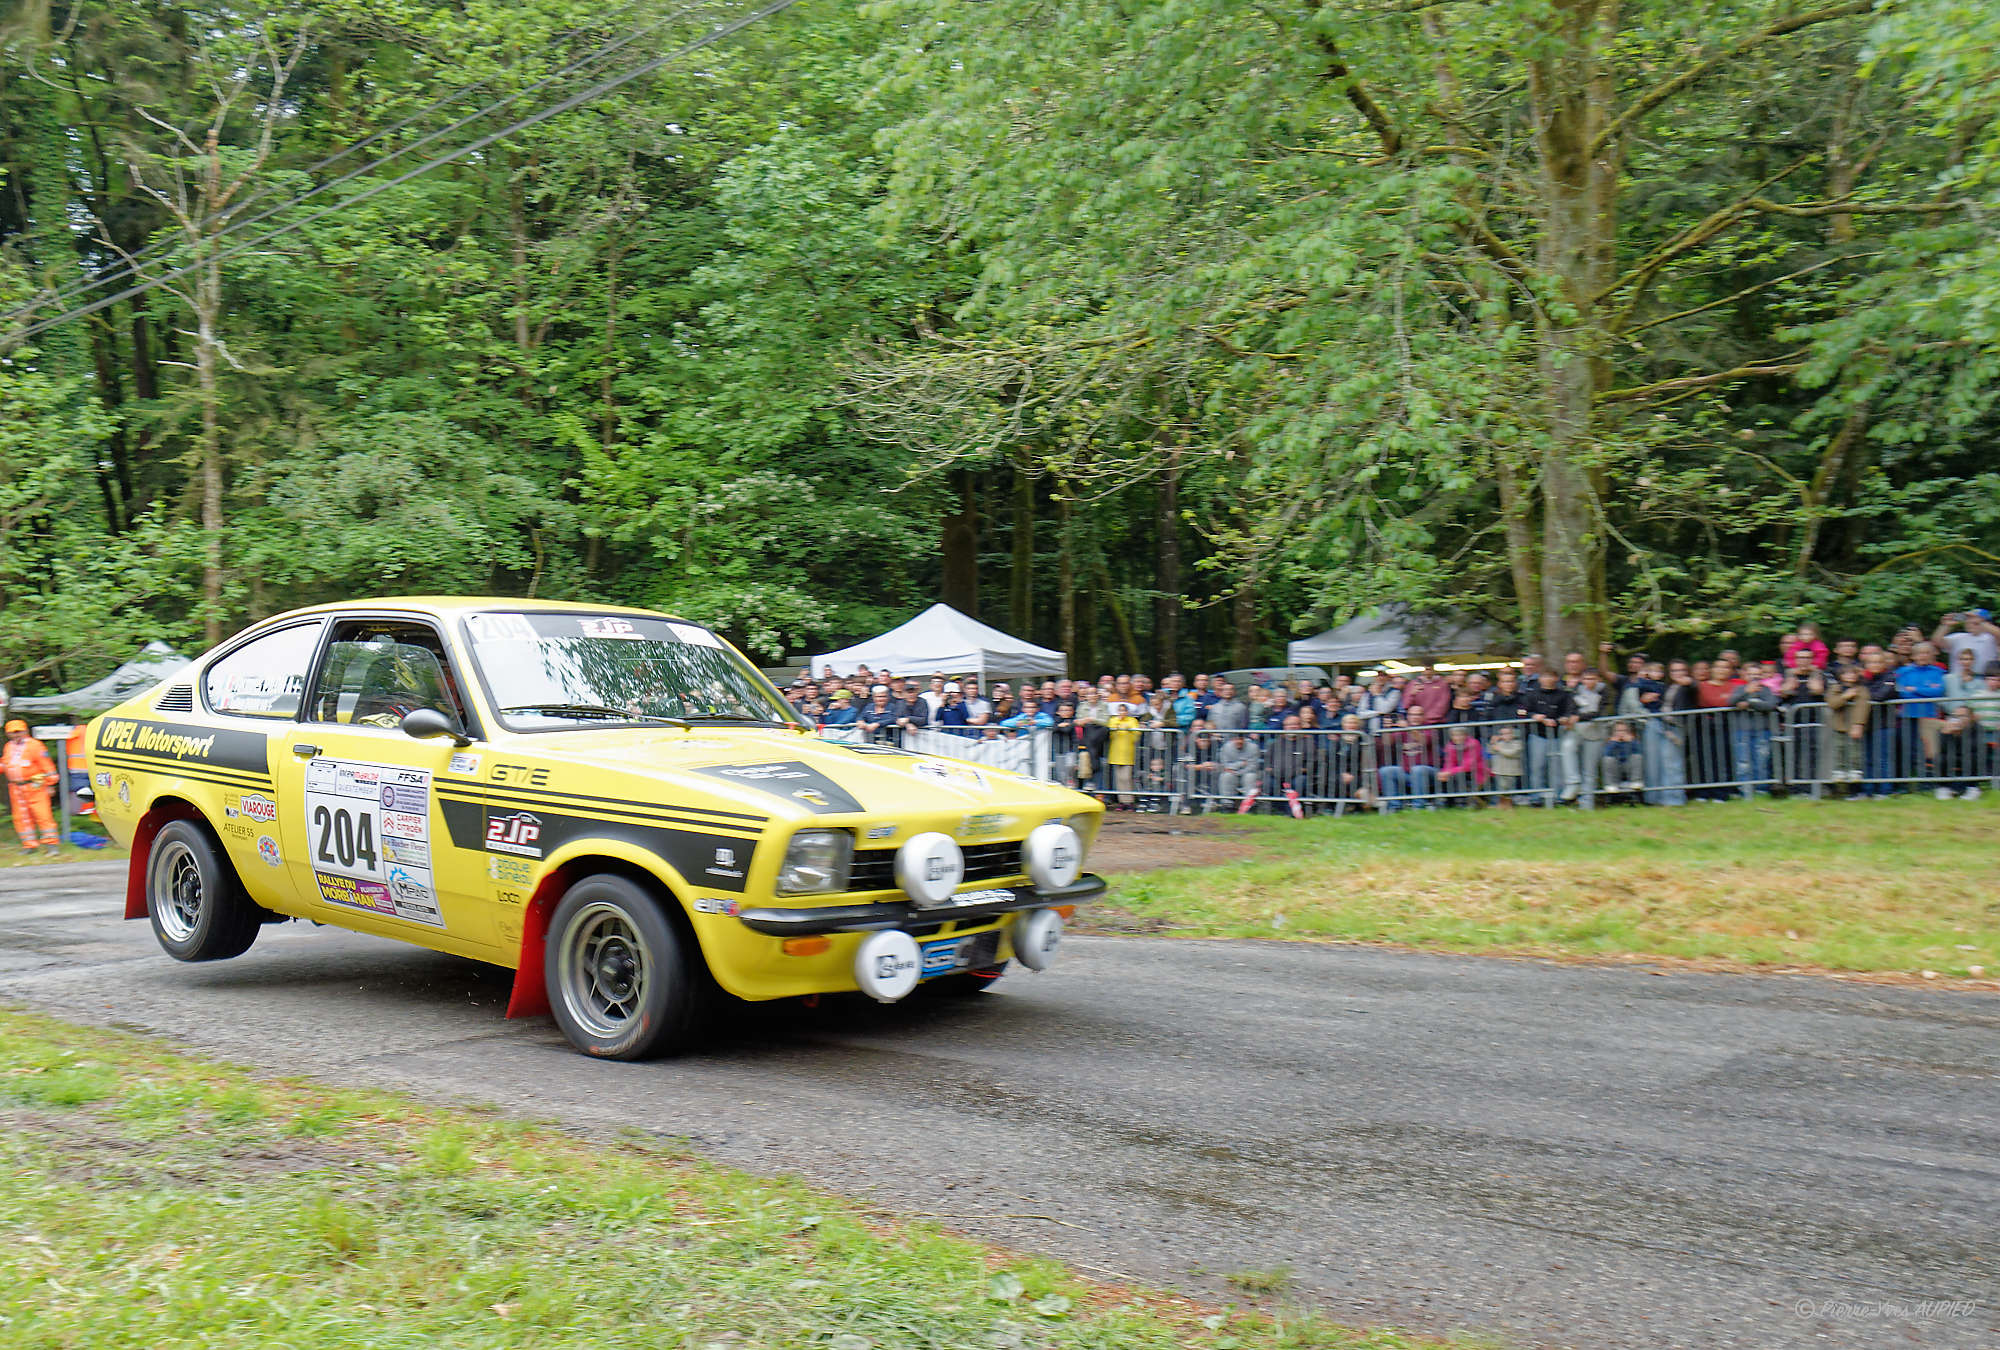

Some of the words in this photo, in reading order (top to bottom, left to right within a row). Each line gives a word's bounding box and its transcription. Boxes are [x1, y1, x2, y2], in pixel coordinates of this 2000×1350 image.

[101, 720, 138, 750] OPEL
[135, 726, 216, 760] Motorsport
[397, 773, 423, 784] FFSA
[491, 763, 551, 786] GT/E
[242, 800, 275, 818] VIAROUGE
[314, 805, 377, 871] 204
[486, 818, 540, 845] 2JP
[317, 873, 345, 888] RALLYE
[344, 879, 356, 890] DU
